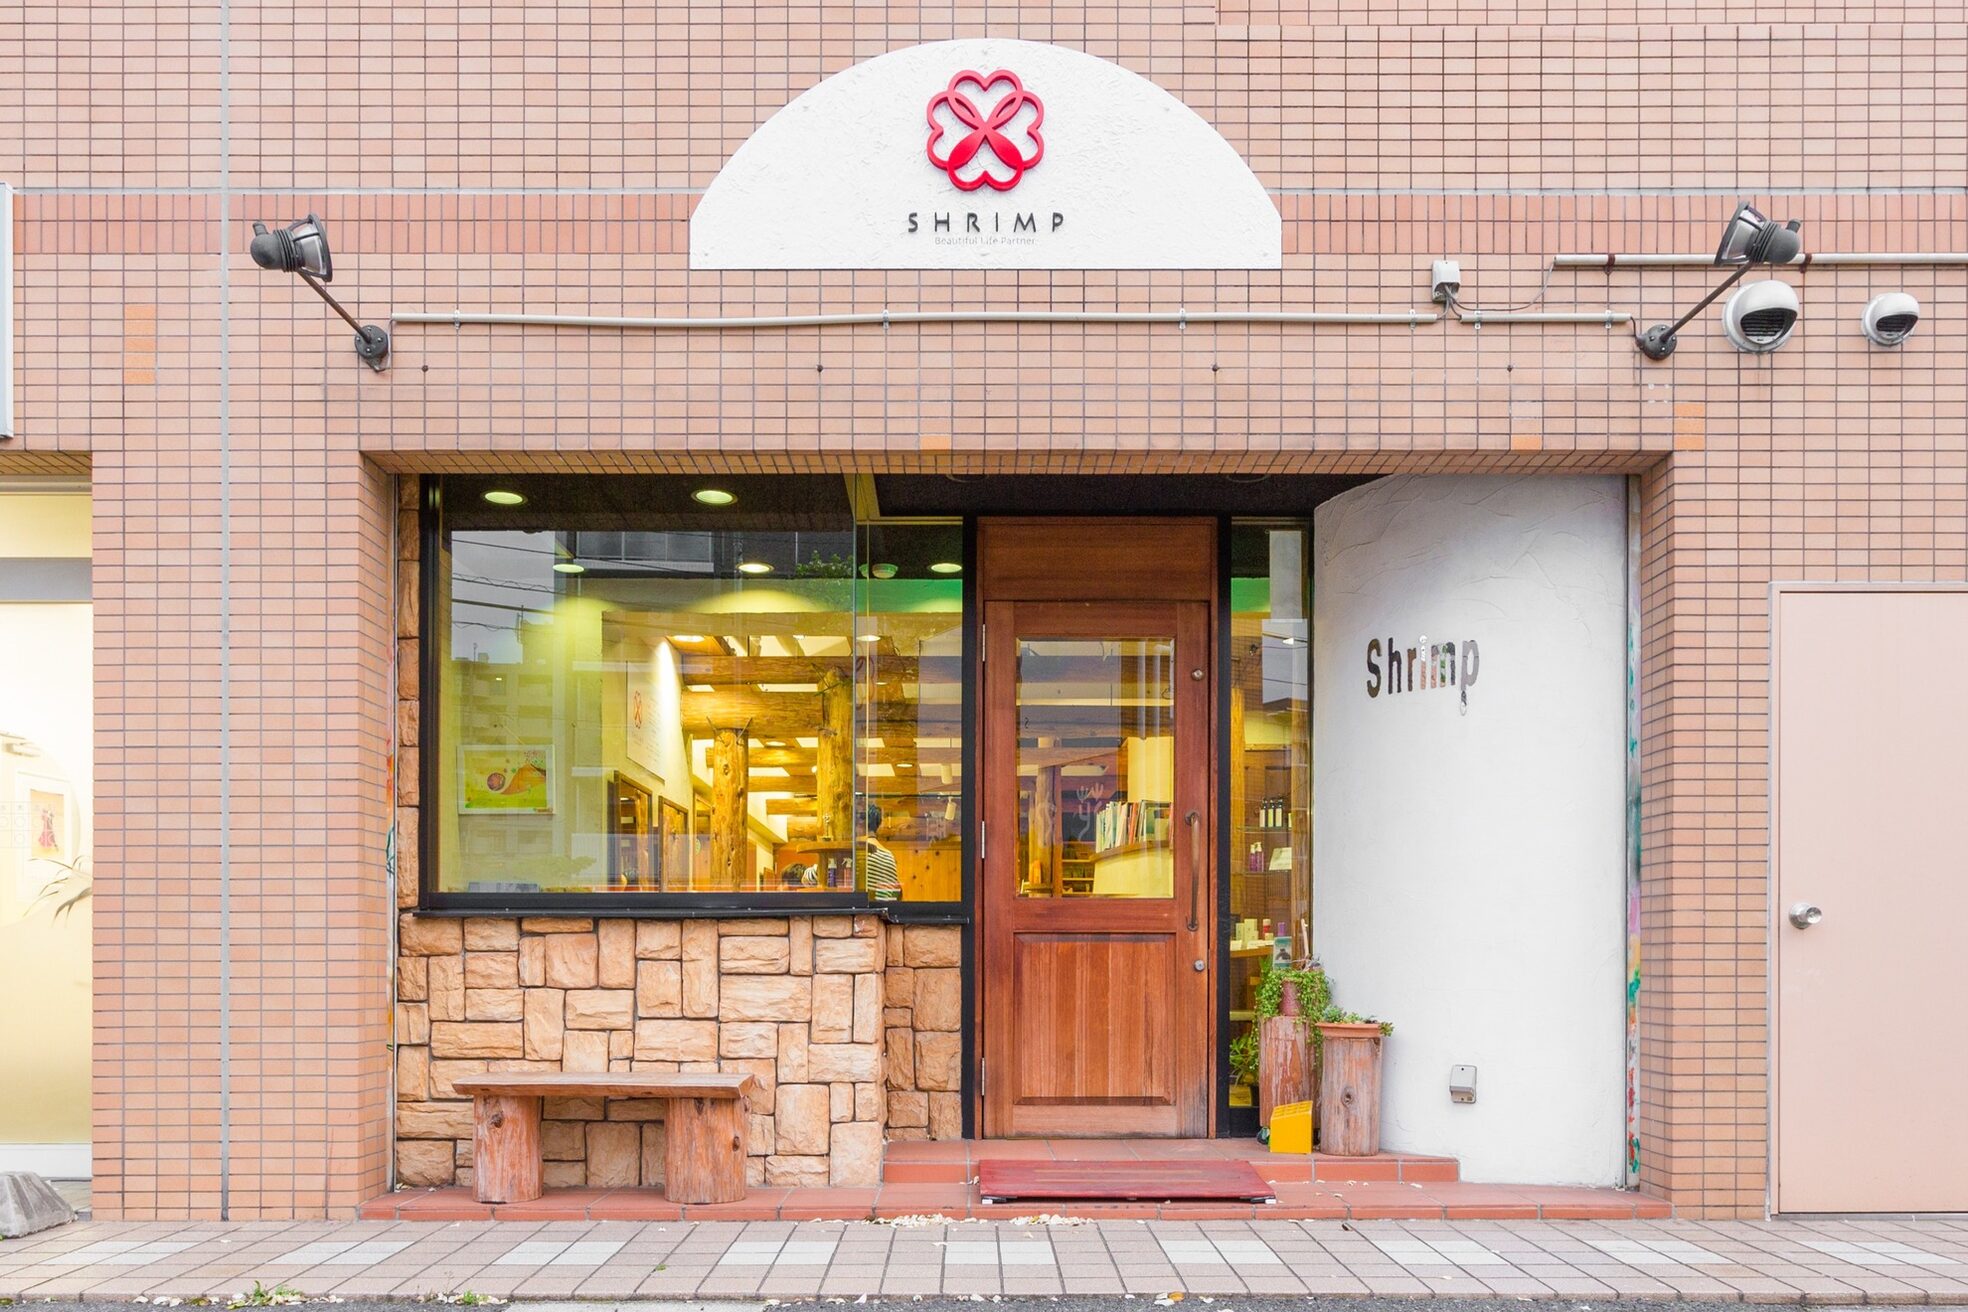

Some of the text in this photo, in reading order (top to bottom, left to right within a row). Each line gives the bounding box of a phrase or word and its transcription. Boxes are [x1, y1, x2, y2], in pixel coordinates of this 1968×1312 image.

[908, 212, 1064, 233] SHRIMP
[934, 236, 1036, 245] Beautiful Life Partner
[1366, 635, 1480, 716] Shrimp
